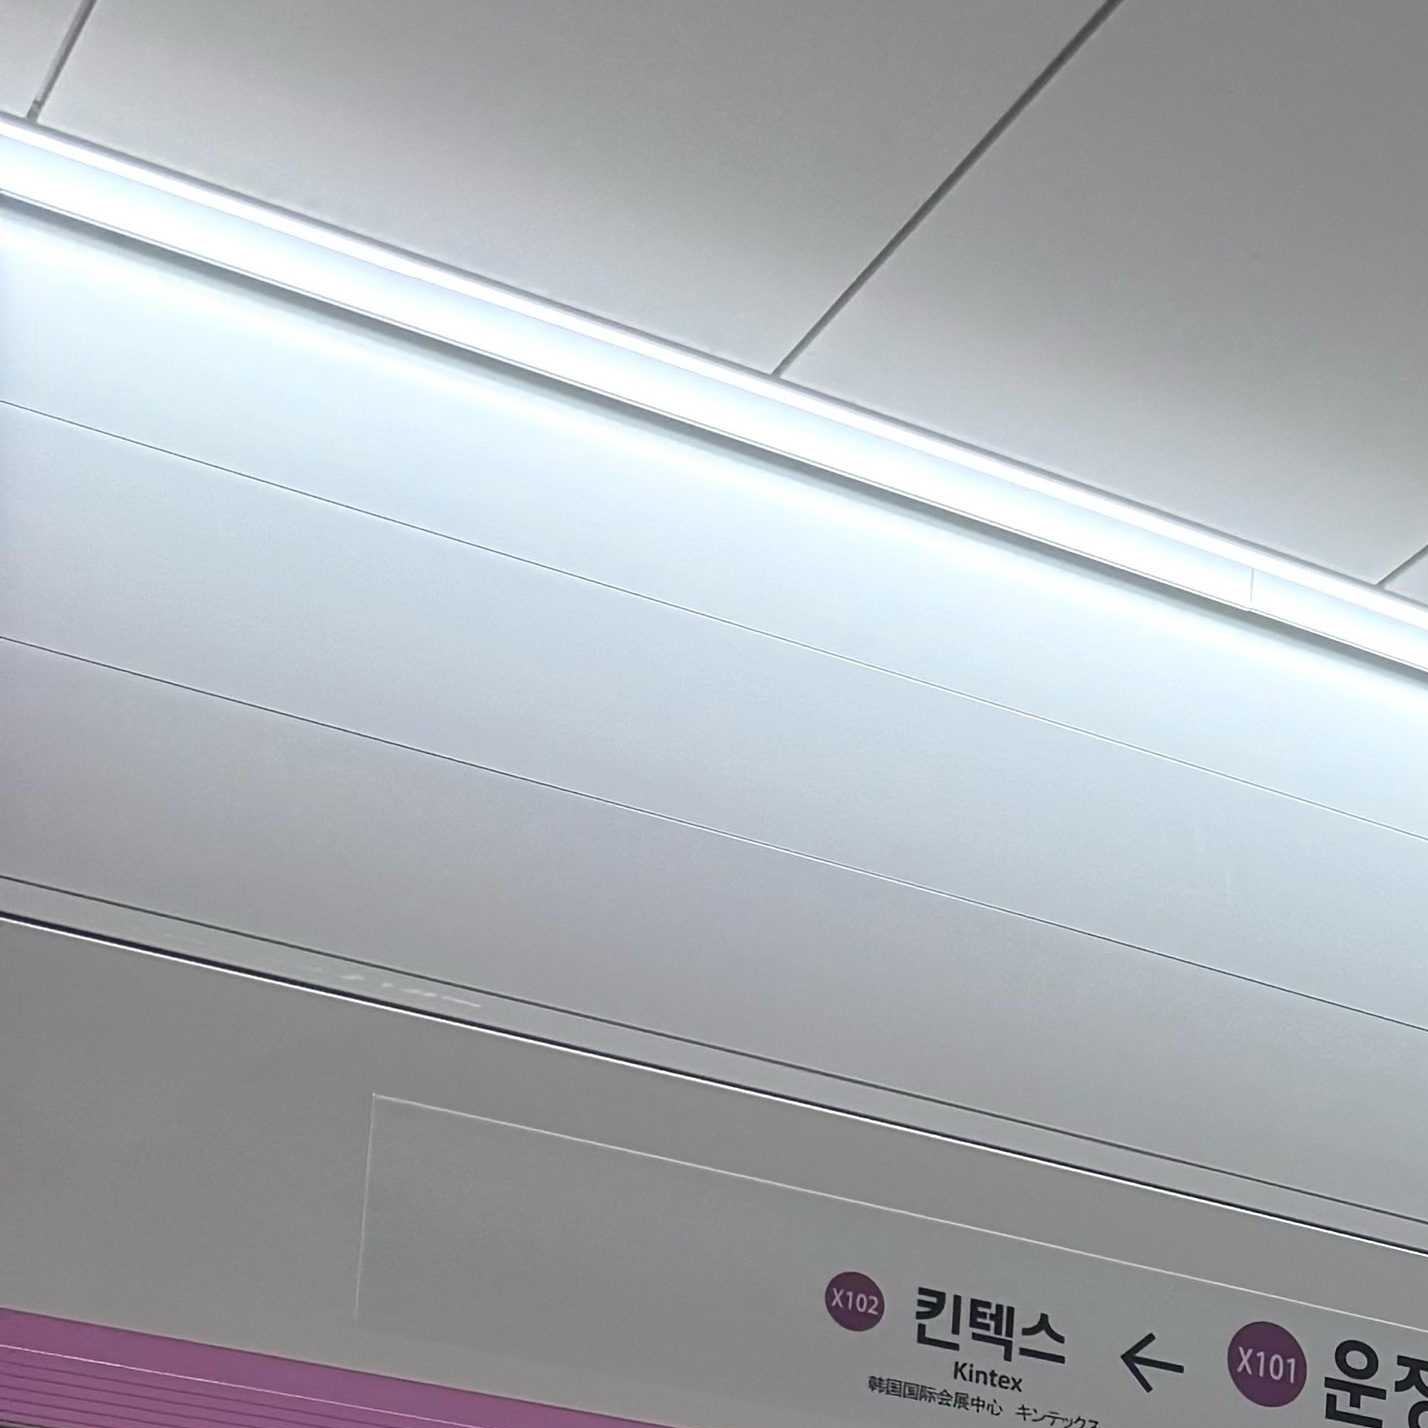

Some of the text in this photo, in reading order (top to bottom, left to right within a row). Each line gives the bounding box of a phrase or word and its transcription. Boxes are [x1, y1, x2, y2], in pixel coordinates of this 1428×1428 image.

[831, 1287, 879, 1316] X102
[915, 1286, 1066, 1363] 킨텍스
[953, 1361, 1023, 1392] Kintex
[1236, 1346, 1297, 1384] X101
